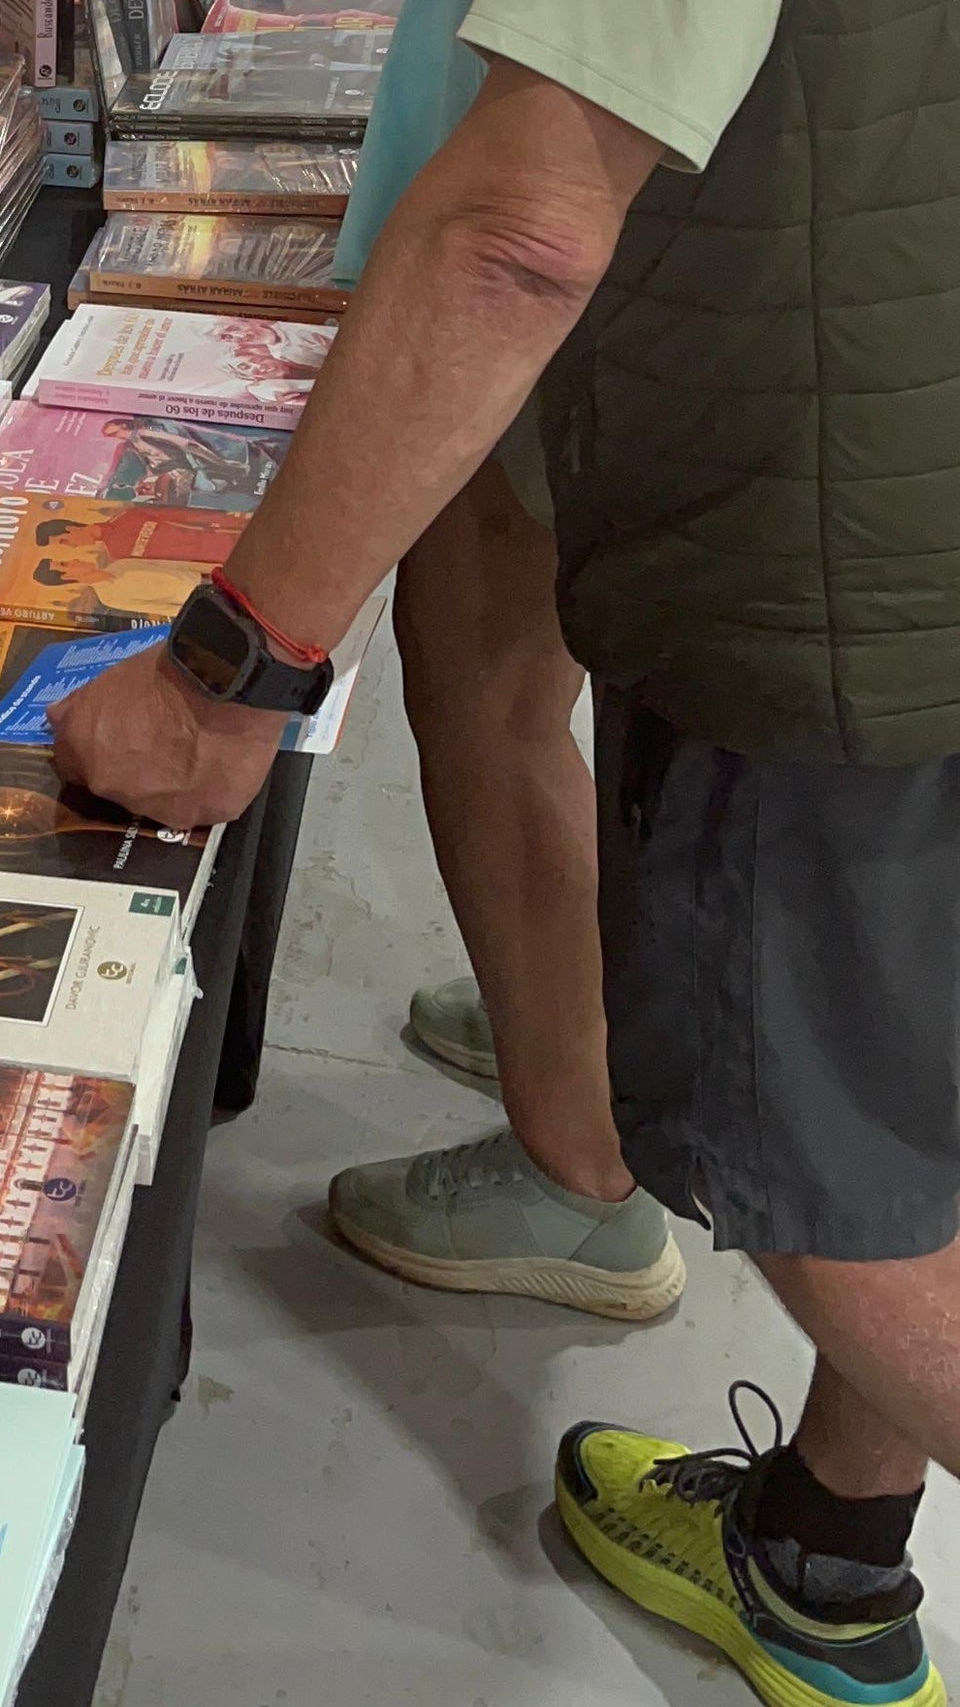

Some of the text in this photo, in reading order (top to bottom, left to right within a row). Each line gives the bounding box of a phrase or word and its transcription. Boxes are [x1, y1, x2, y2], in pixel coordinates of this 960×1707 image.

[165, 403, 264, 424] Después de los 60
[14, 609, 55, 622] ARTURO
[113, 839, 132, 871] PAULINA
[64, 978, 84, 1011] DAVOR
